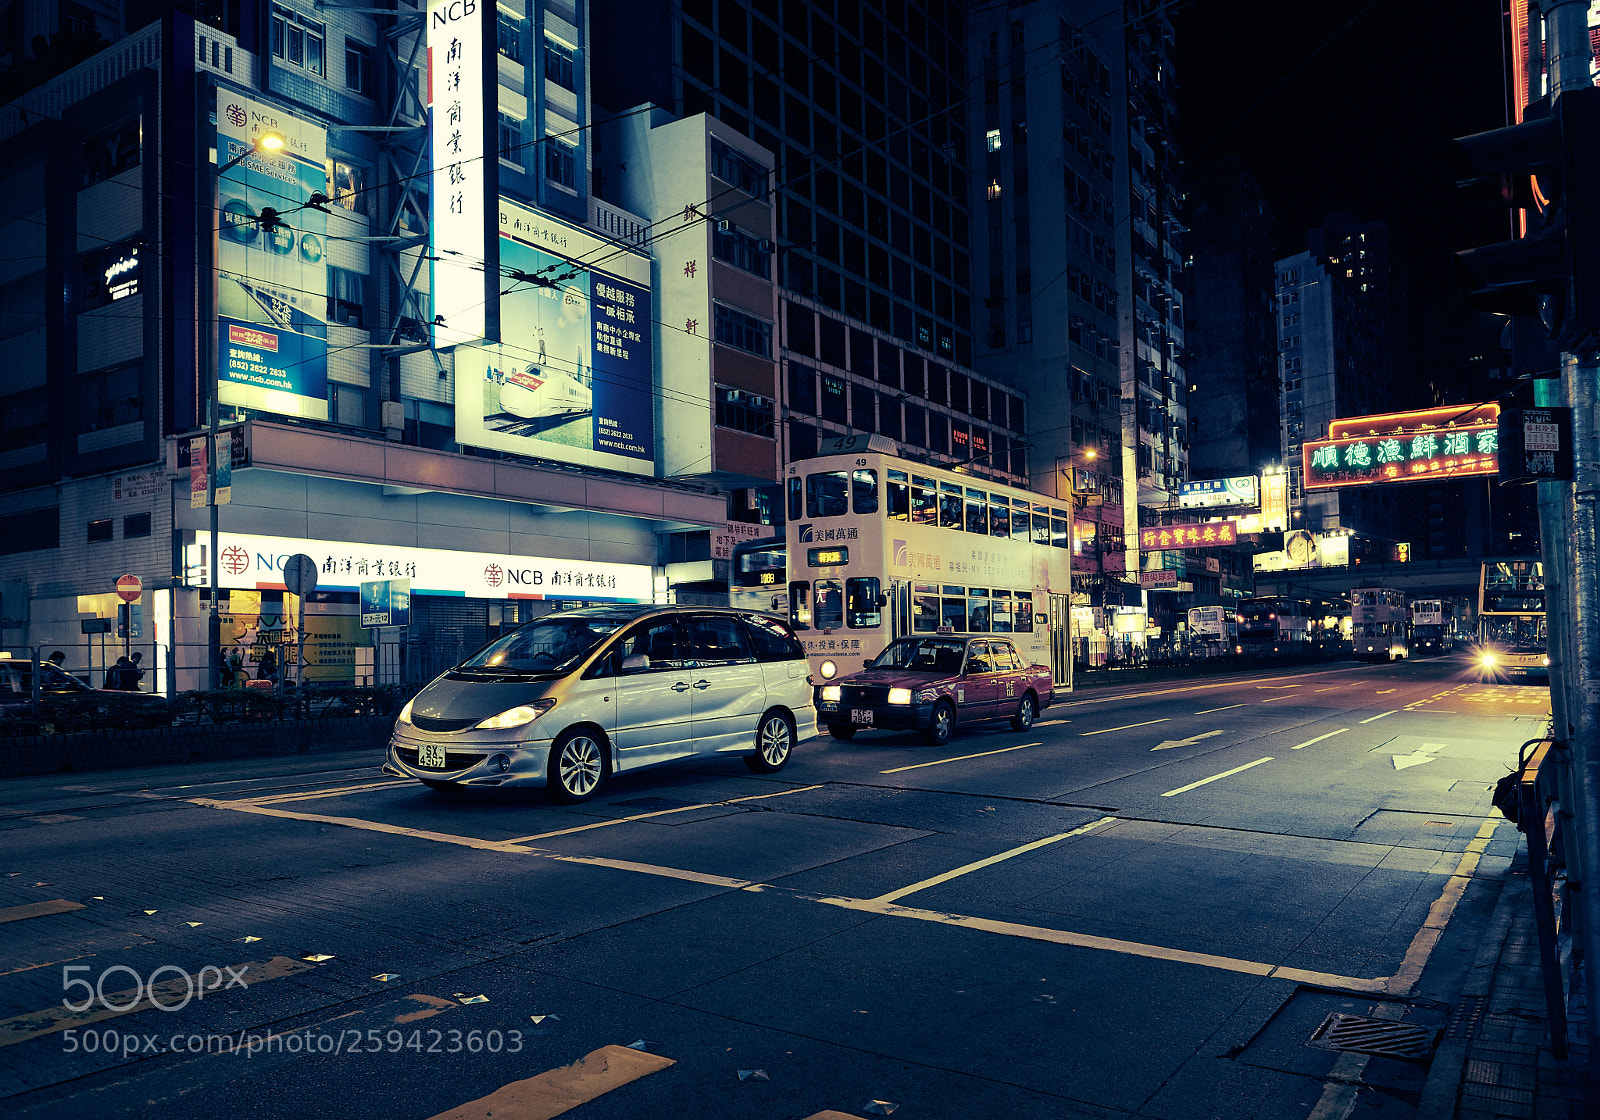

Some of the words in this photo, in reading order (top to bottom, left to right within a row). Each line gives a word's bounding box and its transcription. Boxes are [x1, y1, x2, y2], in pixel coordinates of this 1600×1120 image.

[433, 0, 476, 29] NCB
[251, 111, 278, 128] NCB
[446, 37, 467, 214] 南洋商業銀行
[227, 153, 246, 167] NB
[246, 160, 264, 174] SME
[265, 167, 297, 186] Services
[513, 218, 568, 248] 南洋商業銀行
[595, 282, 635, 308] 優越服務
[596, 304, 635, 324] 一脈相承
[229, 359, 249, 371] (852)
[250, 363, 268, 375] 2622
[229, 371, 293, 389] www.ncb.com.hk
[598, 438, 646, 454] www.ncb.com.hk
[834, 436, 857, 450] 49
[1310, 429, 1498, 468] 順德漁鮮酒家
[855, 458, 867, 467] 49
[814, 527, 859, 543] 美國萬通
[257, 552, 292, 571] NC
[322, 555, 417, 579] 南洋商業銀行
[908, 551, 941, 571] 美國萬通
[507, 569, 543, 586] NCB
[551, 571, 616, 589] 南洋商業銀行
[426, 745, 438, 757] SX
